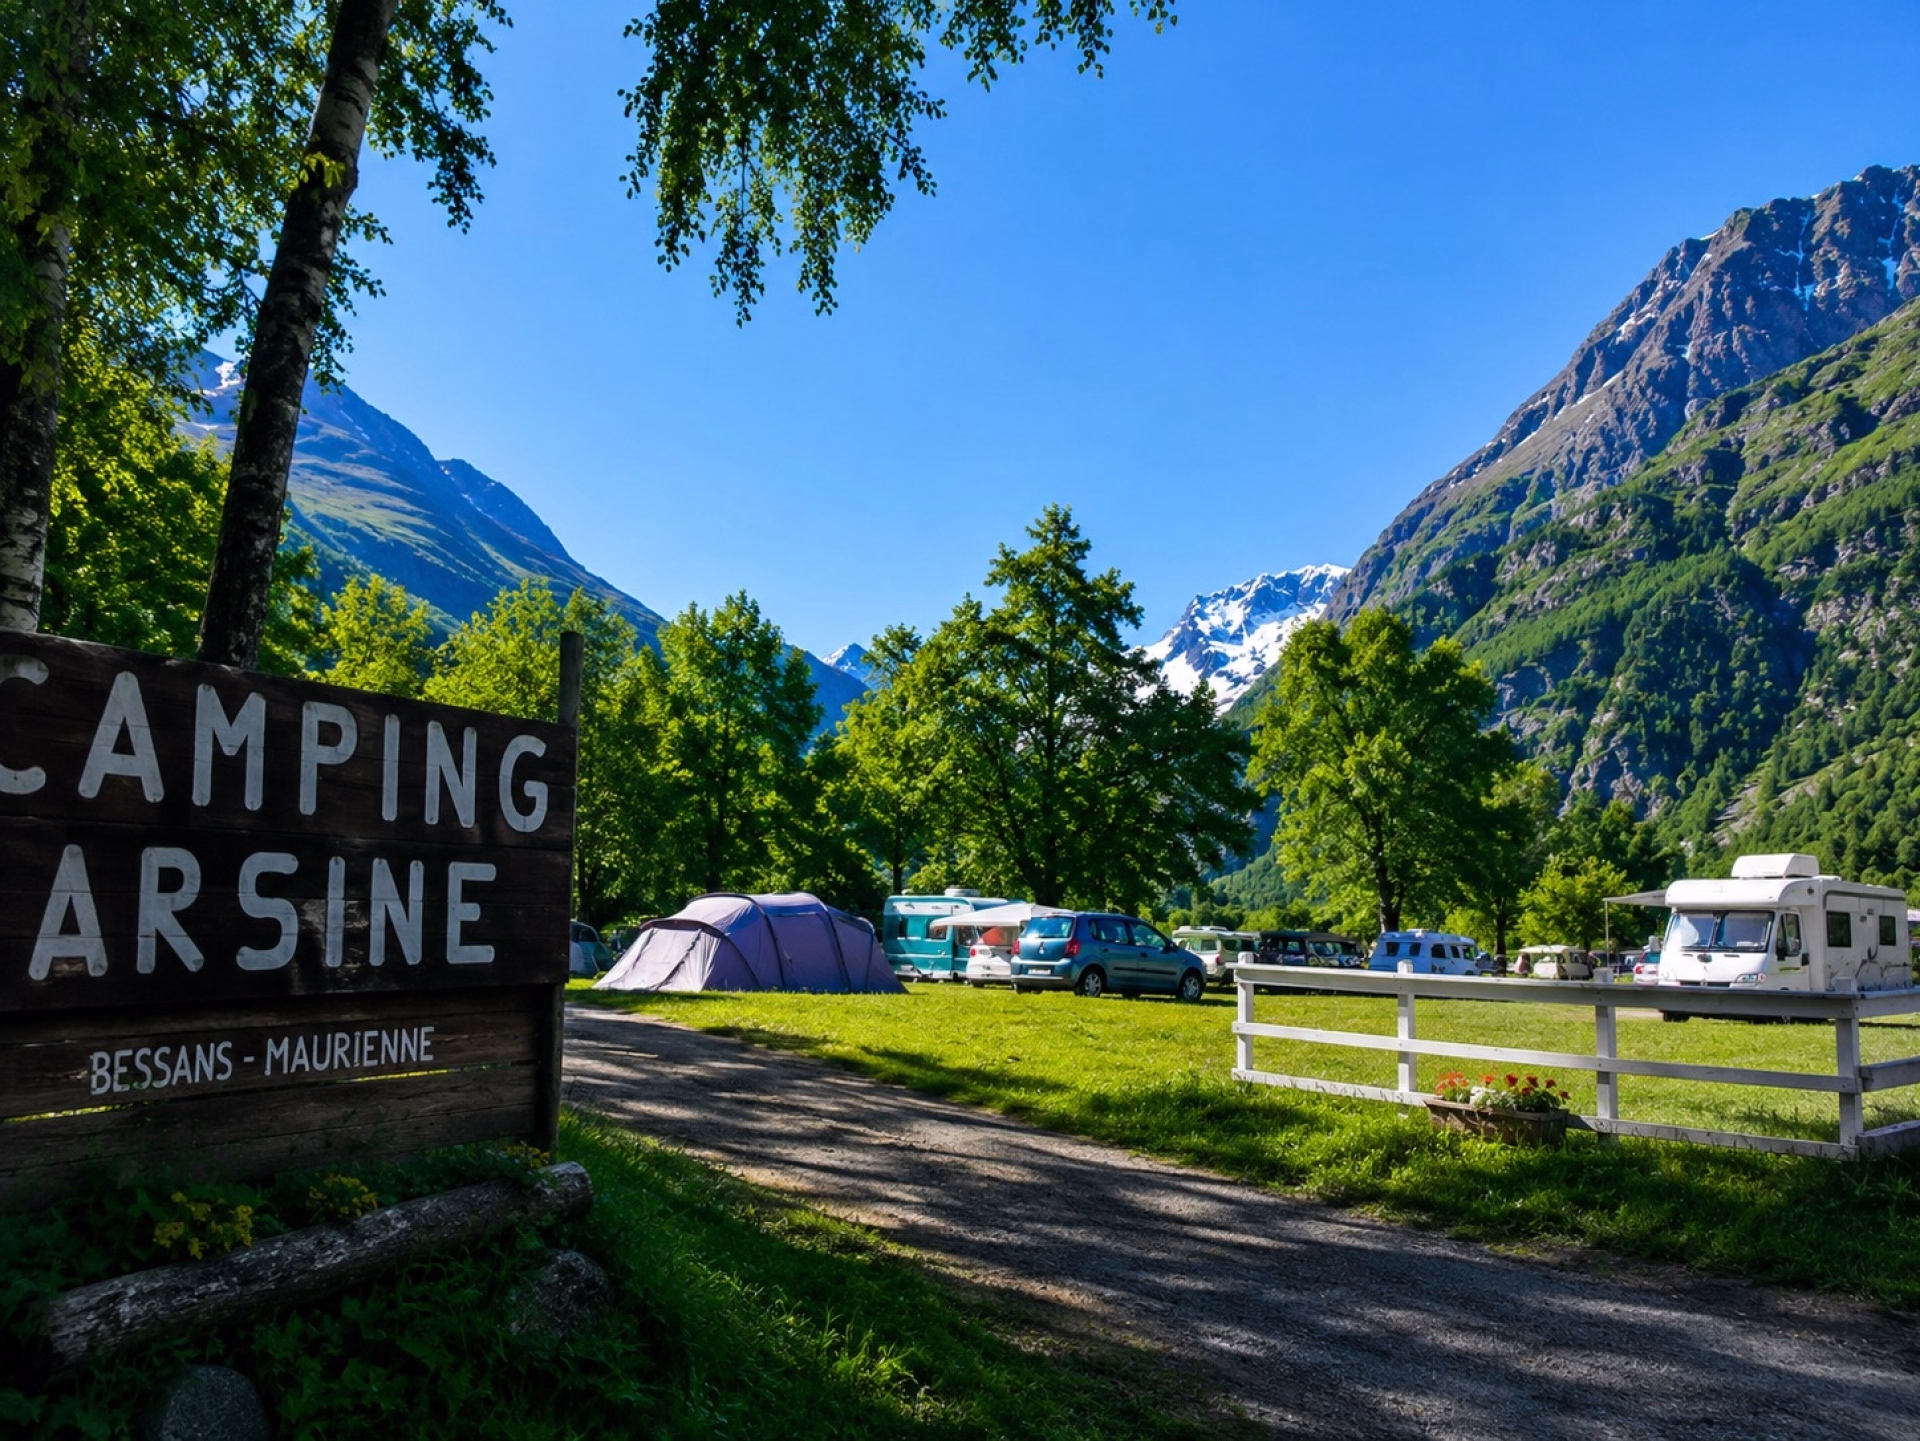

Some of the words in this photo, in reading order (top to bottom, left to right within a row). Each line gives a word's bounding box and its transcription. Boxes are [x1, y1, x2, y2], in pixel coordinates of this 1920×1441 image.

[28, 844, 497, 981] ARSINE
[90, 1041, 233, 1095] BESSANS
[264, 1026, 435, 1076] MAURIENNE
